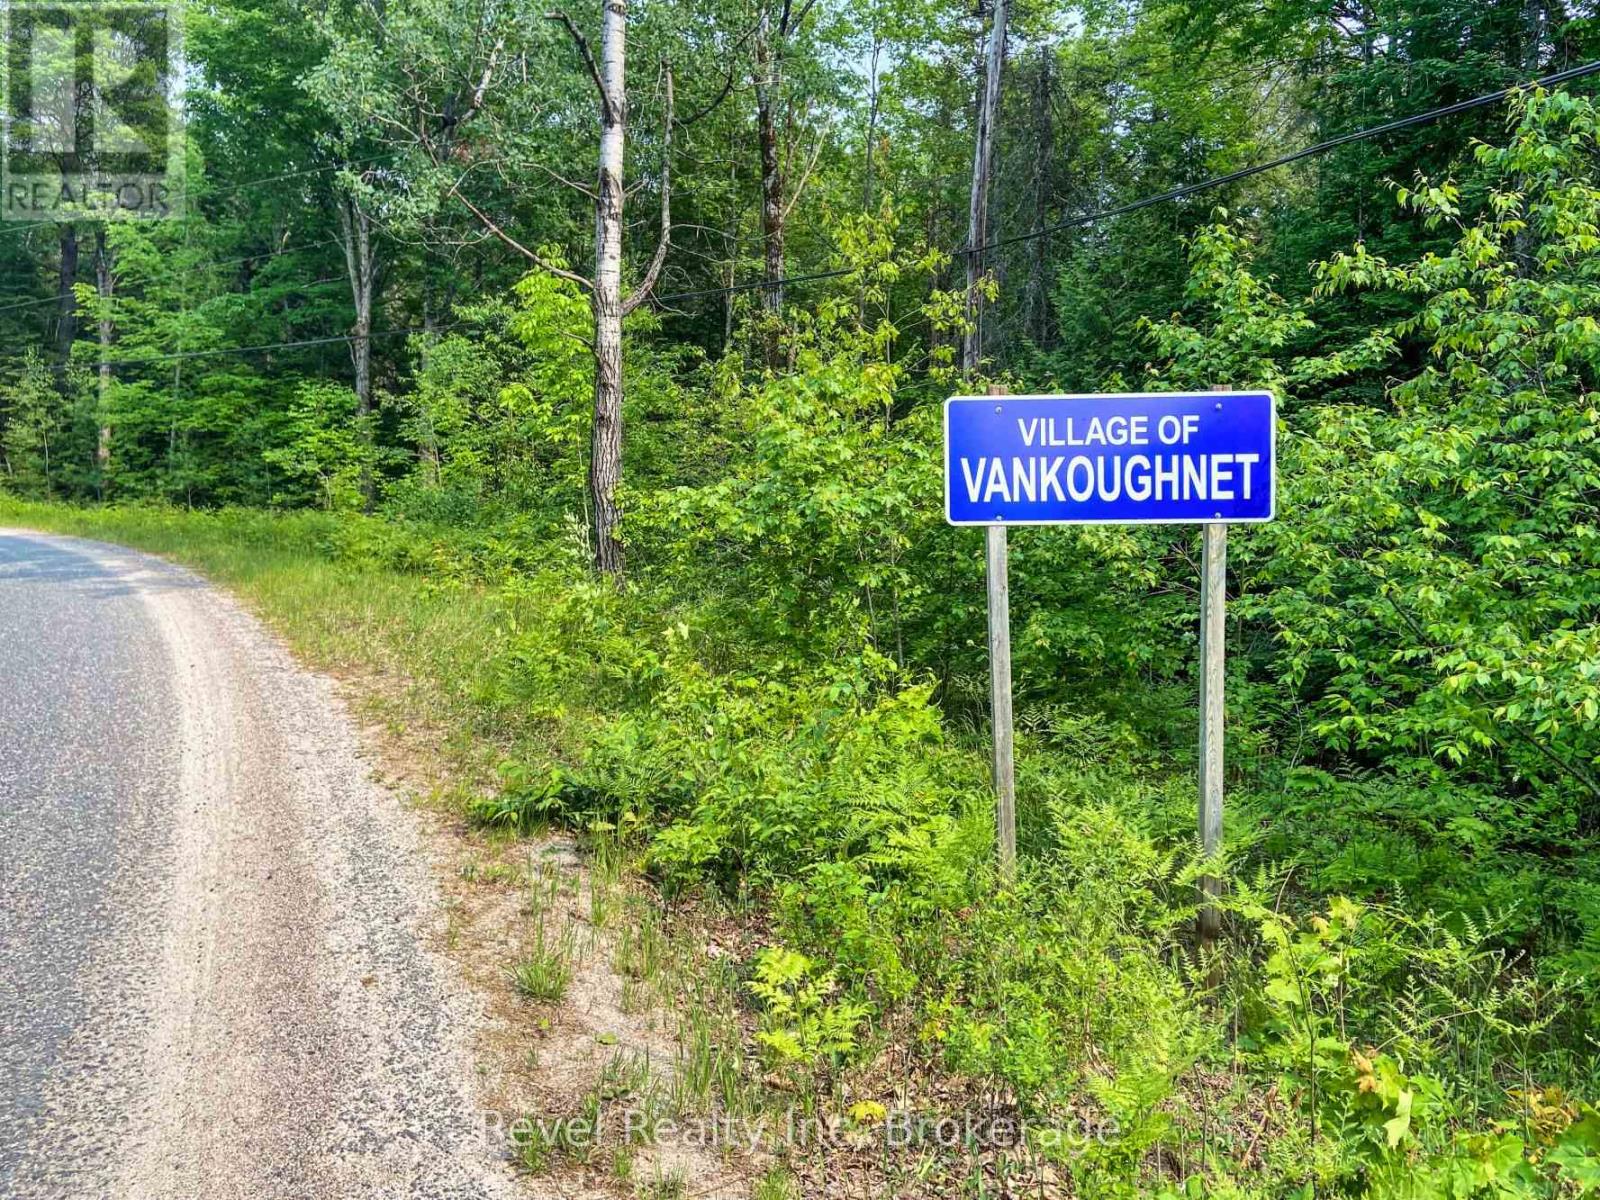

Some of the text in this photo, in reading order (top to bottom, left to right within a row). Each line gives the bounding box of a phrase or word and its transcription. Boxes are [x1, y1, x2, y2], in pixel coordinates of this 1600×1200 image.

[1018, 415, 1200, 447] VILLAGE OF
[960, 453, 1260, 502] VANKOUGHNET
